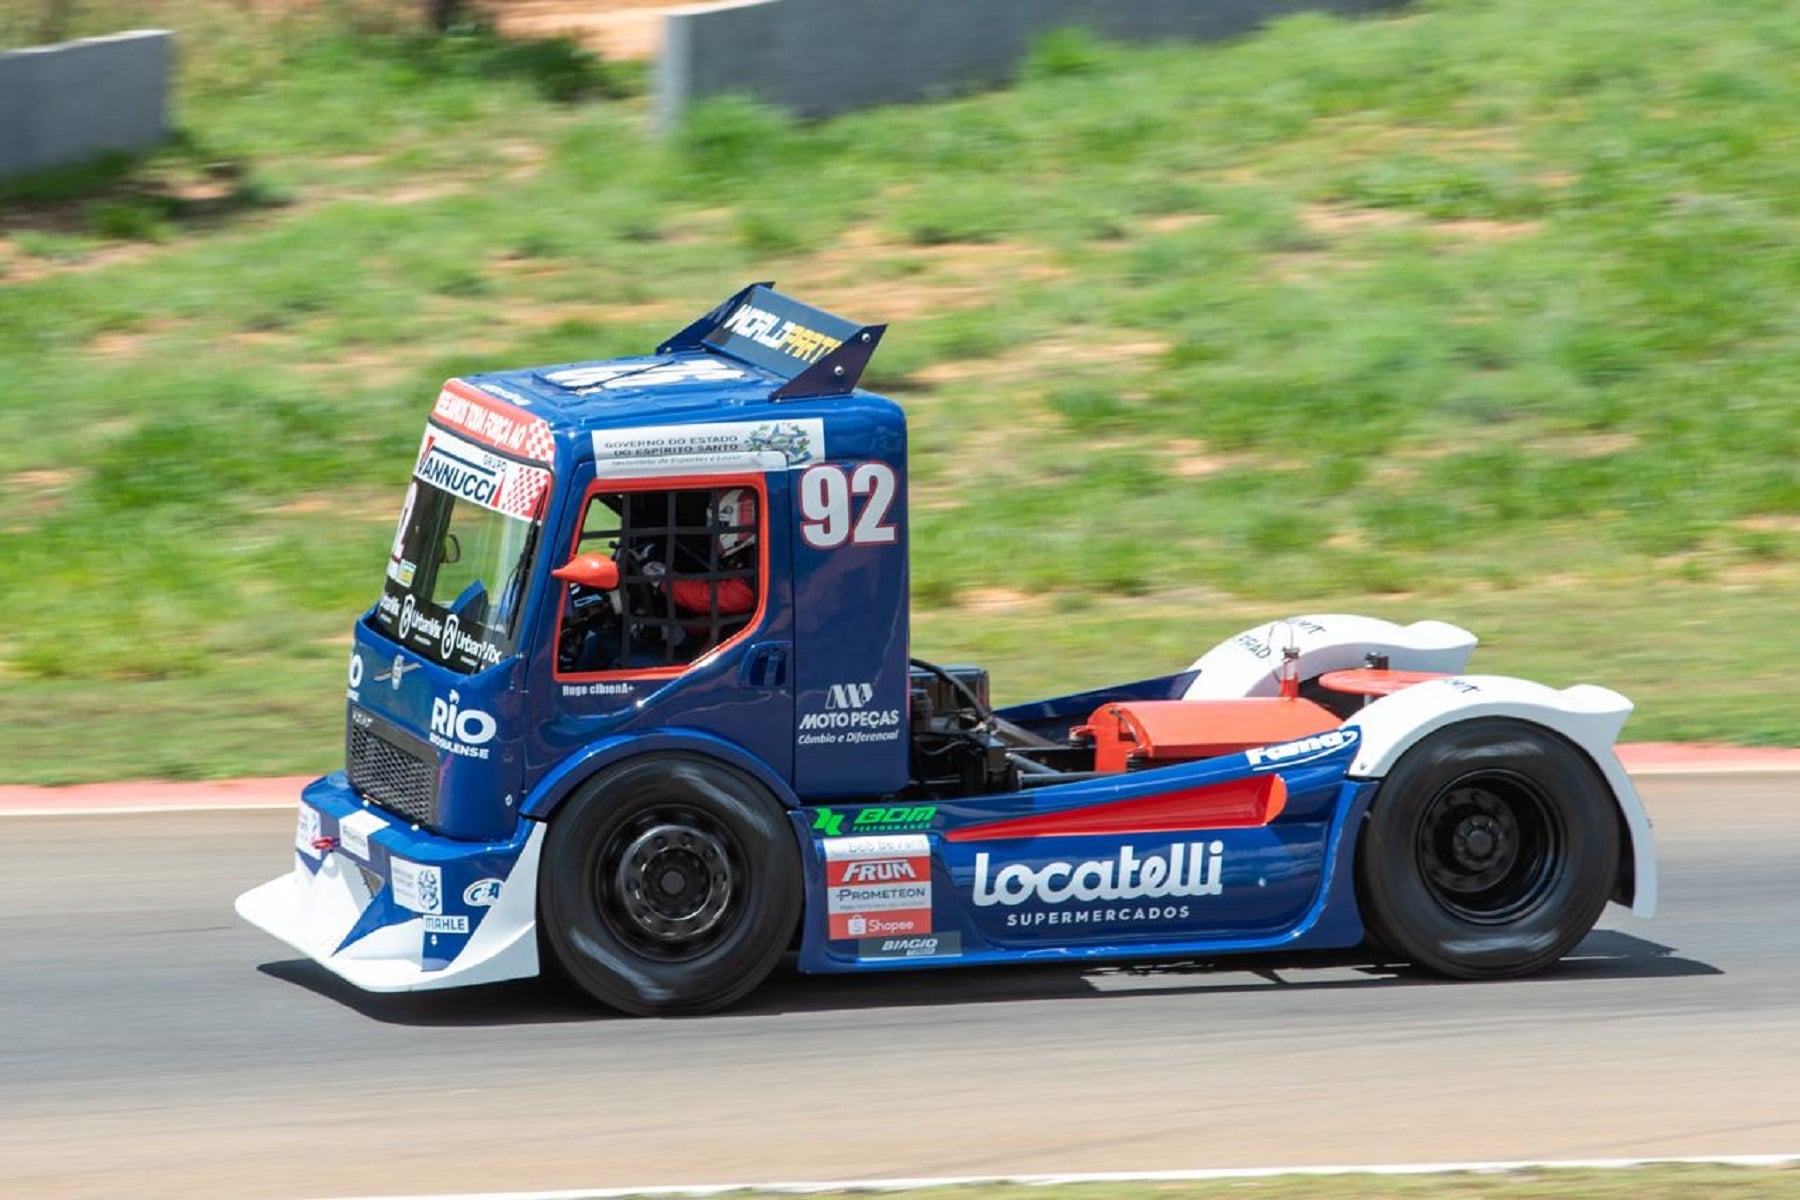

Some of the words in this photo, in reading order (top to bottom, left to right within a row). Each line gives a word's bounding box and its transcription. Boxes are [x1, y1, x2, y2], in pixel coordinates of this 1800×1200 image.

[605, 438, 665, 449] GOVERNO
[668, 437, 686, 446] DO
[690, 434, 738, 445] ESTADO
[614, 448, 631, 457] DO
[635, 444, 693, 456] ESPÍRITO
[697, 442, 738, 452] SANTO
[801, 462, 896, 547] 92
[799, 712, 848, 729] MOTO
[851, 709, 899, 728] PEÇAS
[842, 859, 916, 882] FRUM
[837, 888, 925, 902] PROMETEON
[1007, 905, 1190, 926] SUPERMERCADOS
[425, 917, 465, 931] MAHLE
[868, 920, 914, 933] Shopee
[882, 938, 938, 951] BIAGIO
